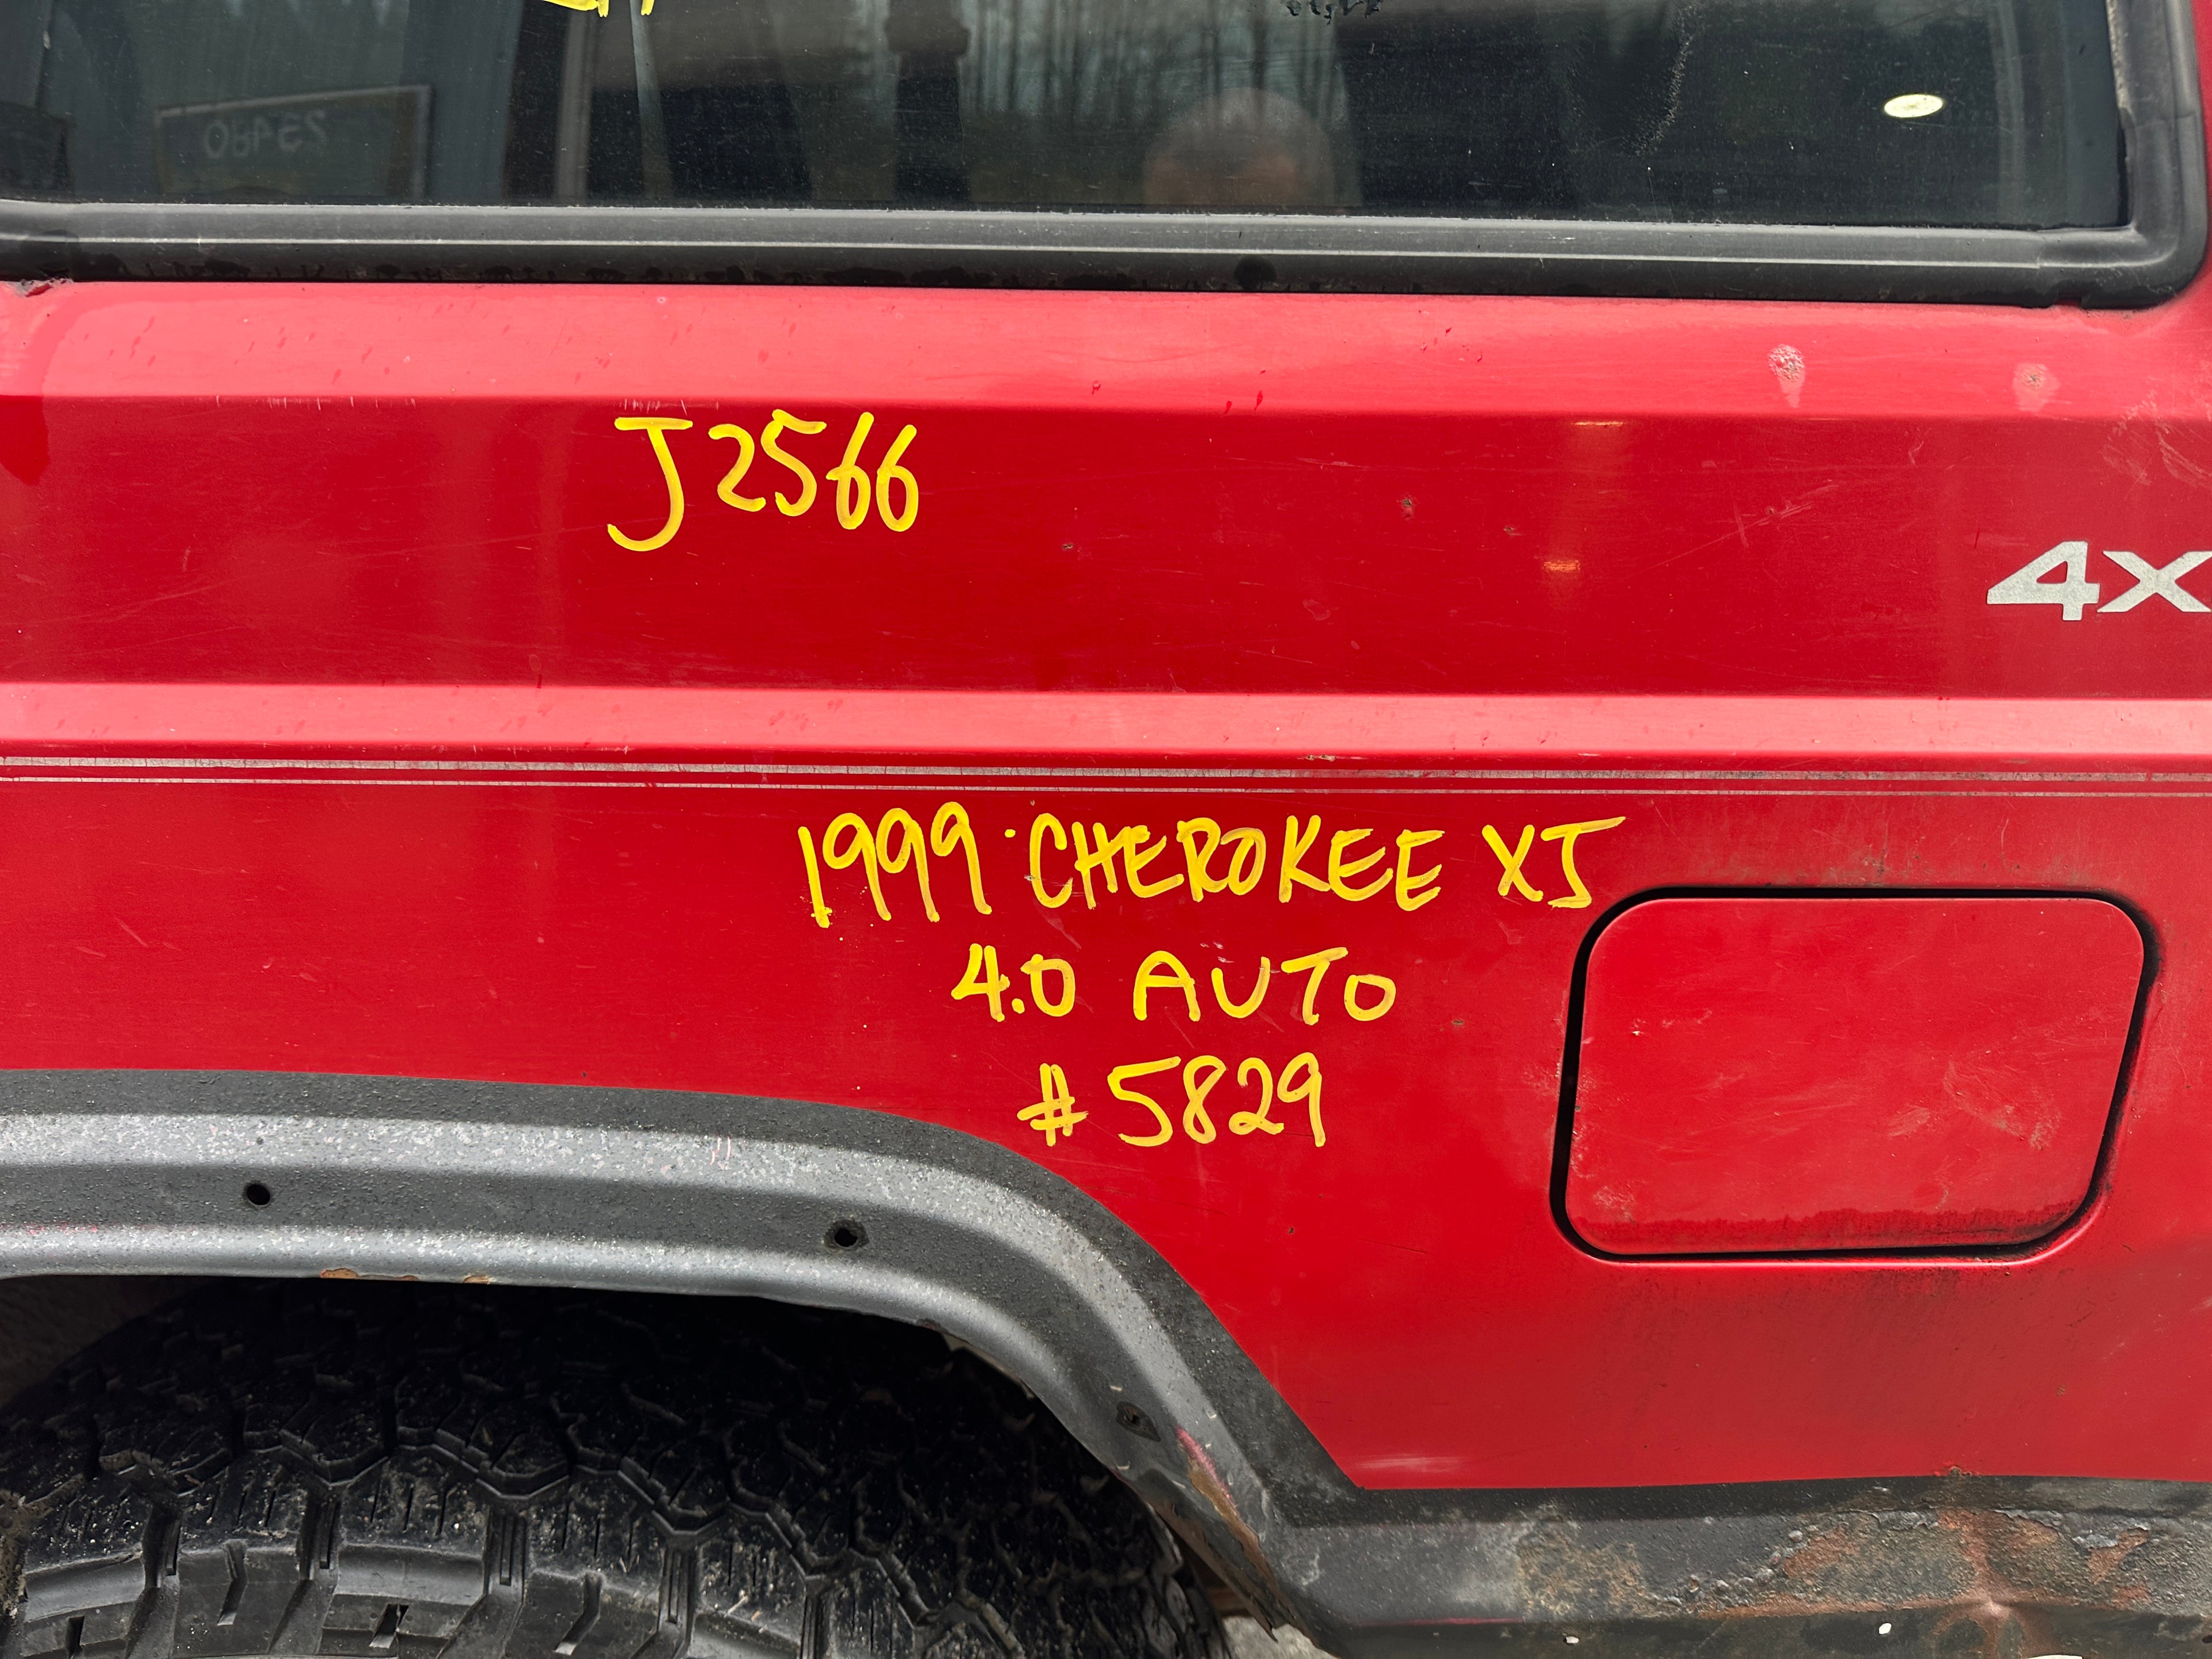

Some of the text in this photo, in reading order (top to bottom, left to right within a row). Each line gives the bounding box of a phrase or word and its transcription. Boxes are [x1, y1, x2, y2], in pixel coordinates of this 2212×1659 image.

[797, 801, 1627, 929] 1999 CHEROKEE XJ
[950, 943, 1396, 1026] 4.0 AUTO
